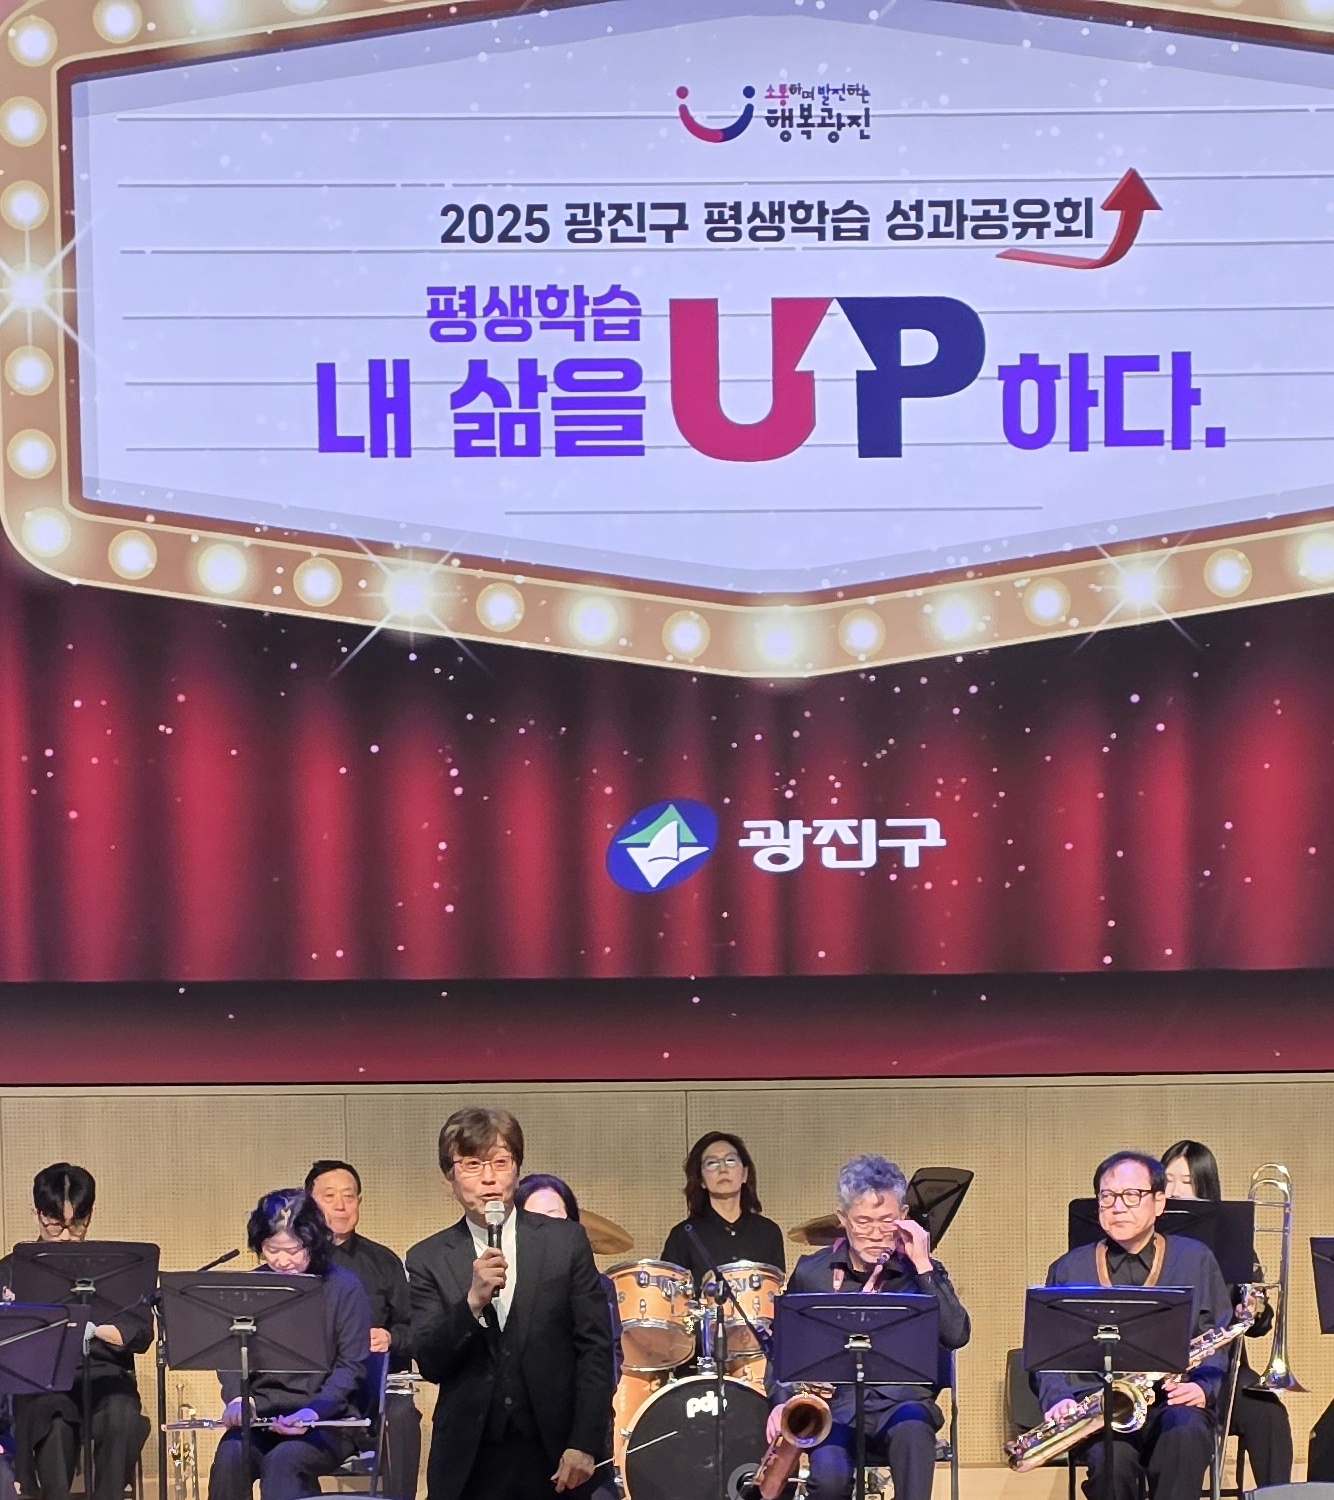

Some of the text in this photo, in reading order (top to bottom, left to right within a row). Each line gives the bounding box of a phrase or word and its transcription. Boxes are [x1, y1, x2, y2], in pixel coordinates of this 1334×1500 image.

[764, 83, 871, 106] 소통하며 발전하는
[764, 103, 871, 143] 행복광진
[440, 198, 1094, 244] 2025 광진구 평생학습 성과공유회
[426, 285, 642, 343] 평생학습
[316, 359, 413, 458] 내
[450, 358, 646, 458] 삶을
[738, 818, 947, 872] 광진구
